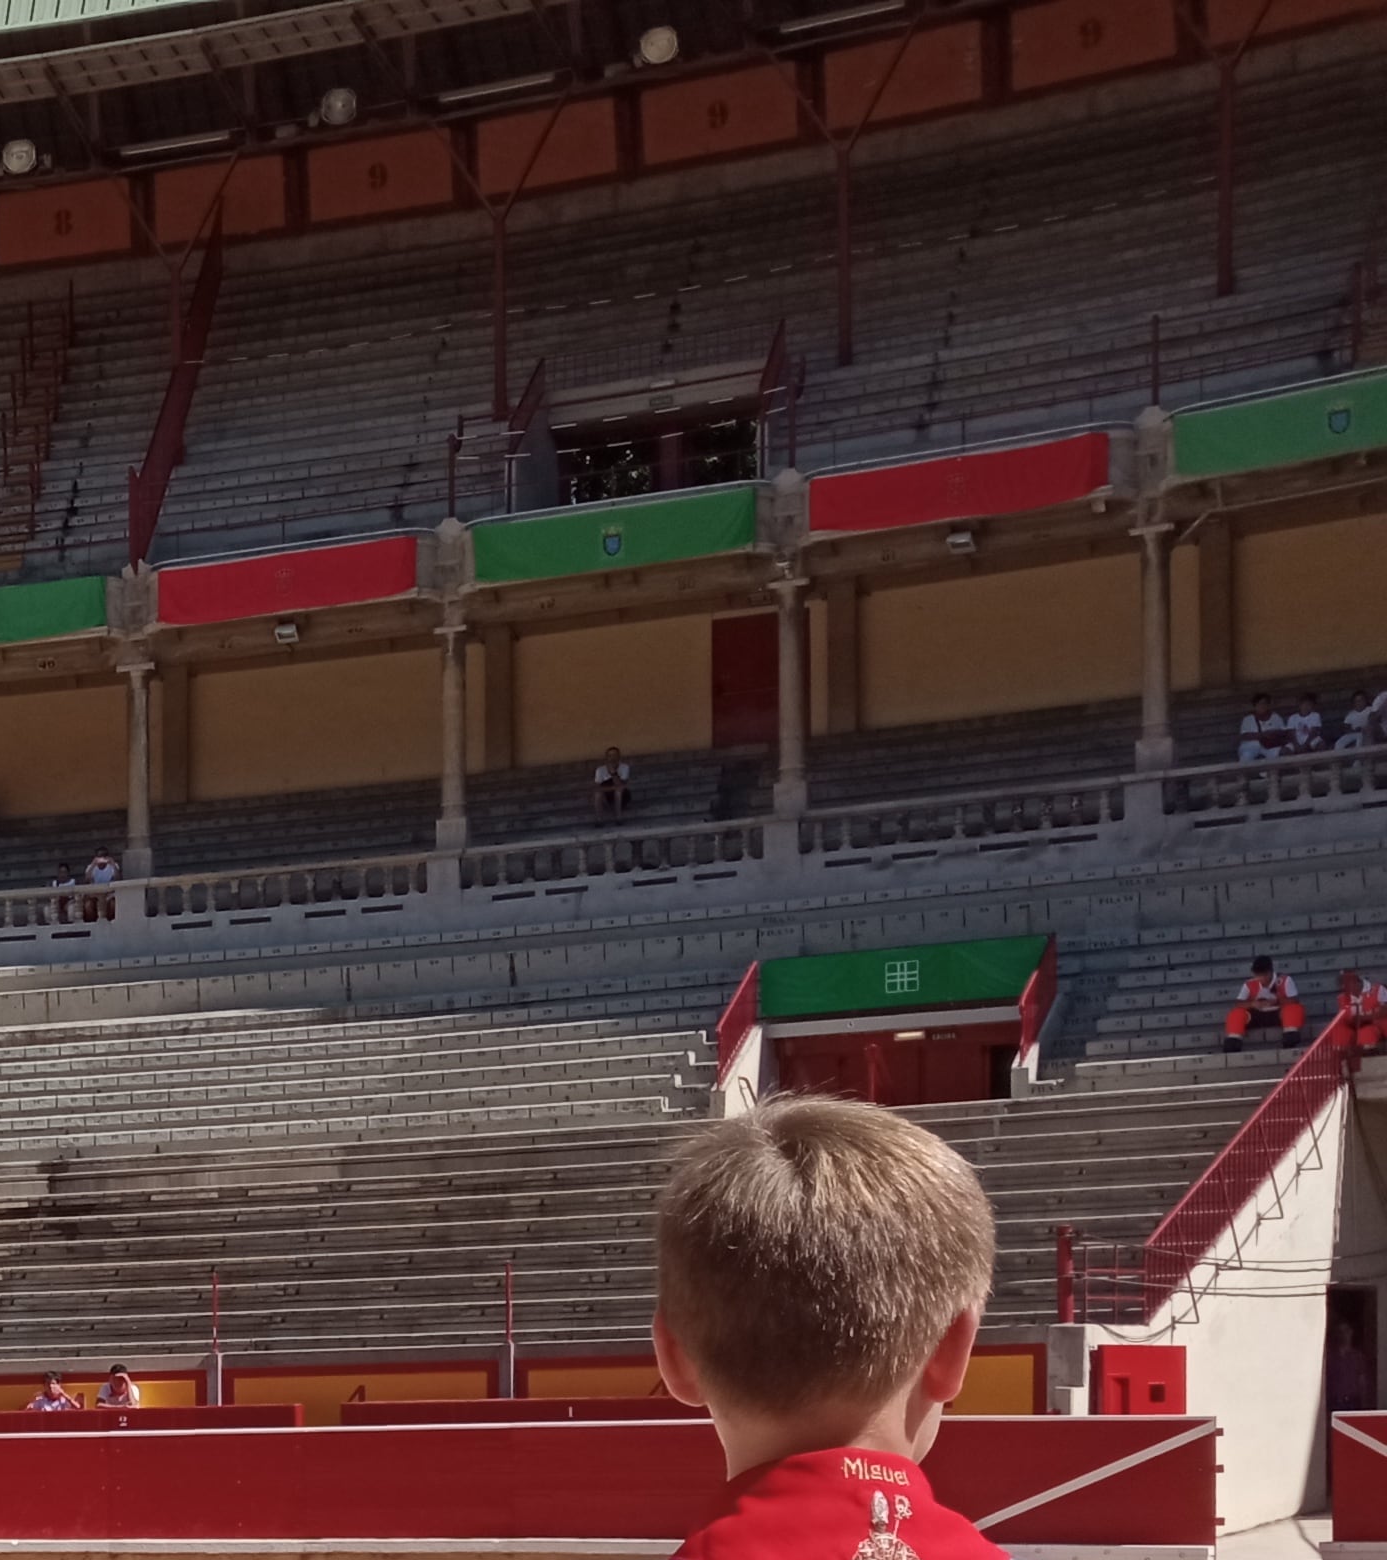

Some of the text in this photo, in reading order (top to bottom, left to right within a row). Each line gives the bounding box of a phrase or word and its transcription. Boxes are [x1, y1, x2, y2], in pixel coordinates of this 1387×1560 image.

[707, 101, 729, 129] 9
[368, 162, 388, 190] 9
[55, 209, 74, 236] 8
[843, 1456, 911, 1487] Miguel
